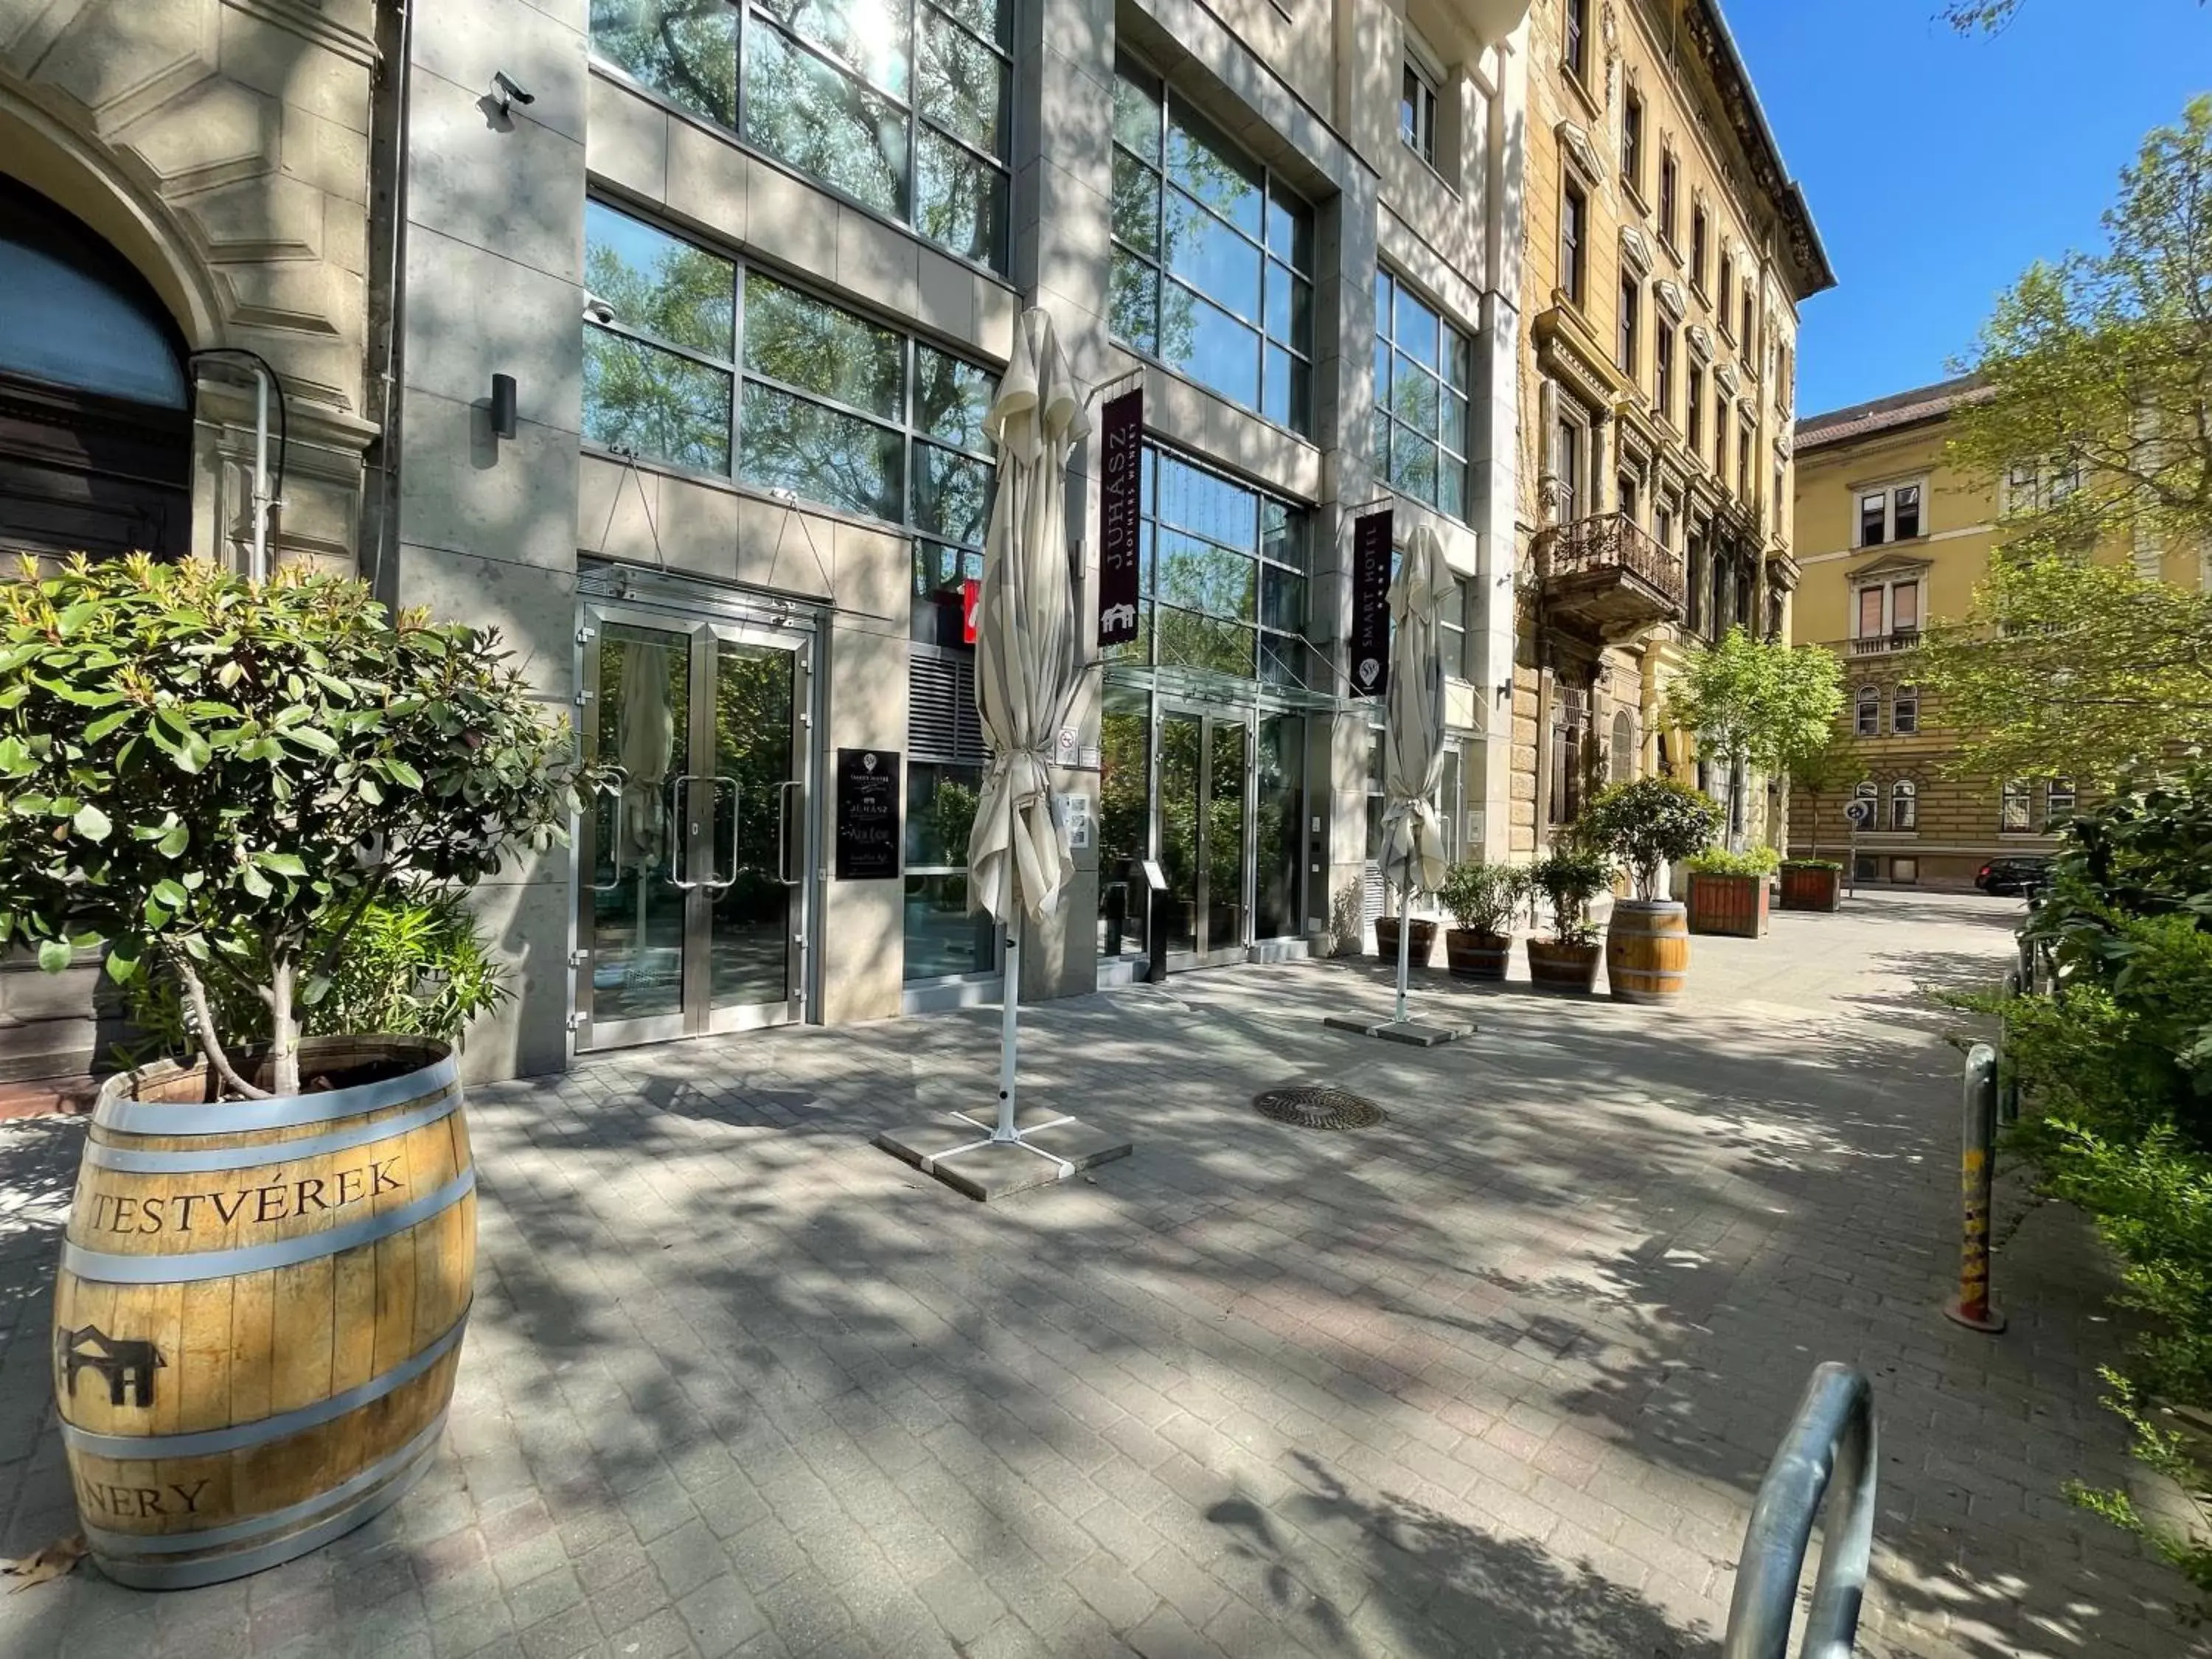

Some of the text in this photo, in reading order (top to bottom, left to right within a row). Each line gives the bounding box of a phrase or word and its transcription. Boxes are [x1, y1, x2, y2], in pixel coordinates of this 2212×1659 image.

[1107, 426, 1126, 570] JUHÁSZ
[1125, 422, 1136, 567] BROTHERS WINERY
[1364, 526, 1377, 582] HOTEL
[1362, 592, 1374, 647] SMART
[93, 1156, 405, 1235] TESTVÉREK
